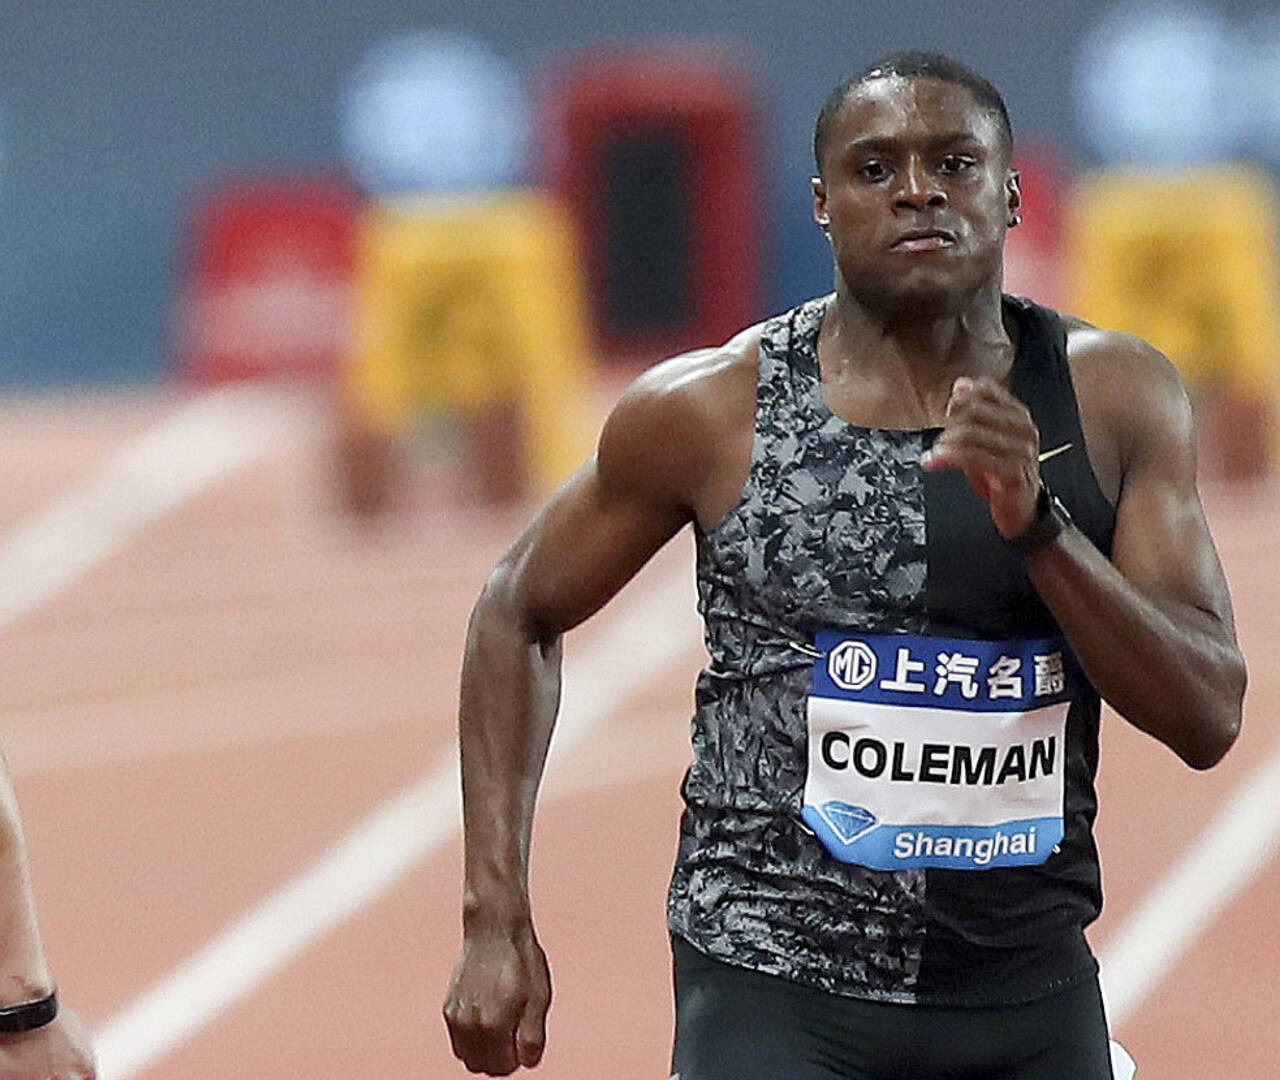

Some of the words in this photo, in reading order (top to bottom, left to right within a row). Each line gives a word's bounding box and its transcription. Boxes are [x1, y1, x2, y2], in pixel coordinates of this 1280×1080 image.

[880, 648, 1066, 699] 上汽名爵
[820, 731, 1056, 785] COLEMAN
[893, 827, 1036, 865] Shanghai
